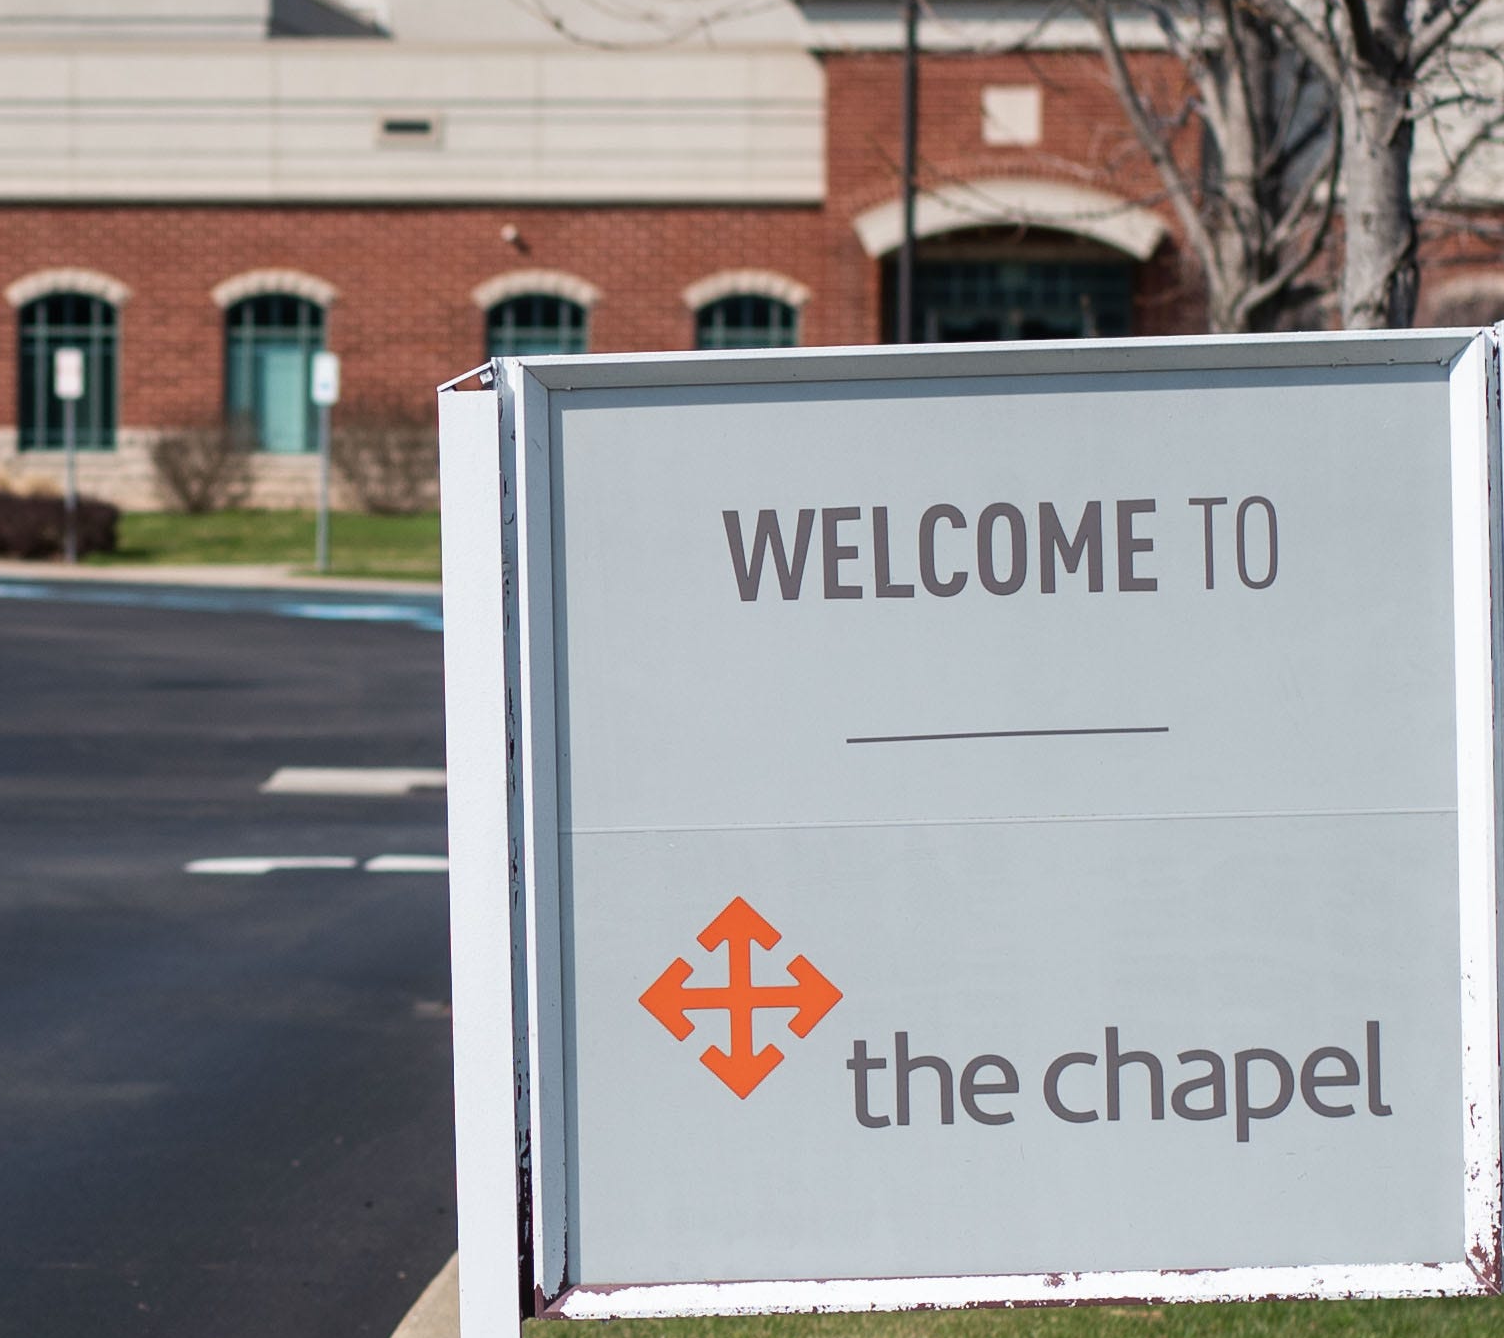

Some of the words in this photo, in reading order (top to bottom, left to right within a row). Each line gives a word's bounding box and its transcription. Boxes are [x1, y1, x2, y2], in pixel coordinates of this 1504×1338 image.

[721, 498, 1158, 602] WELCOME
[1188, 495, 1279, 591] TO
[846, 1031, 1020, 1129] the
[1043, 1020, 1393, 1143] chapel
